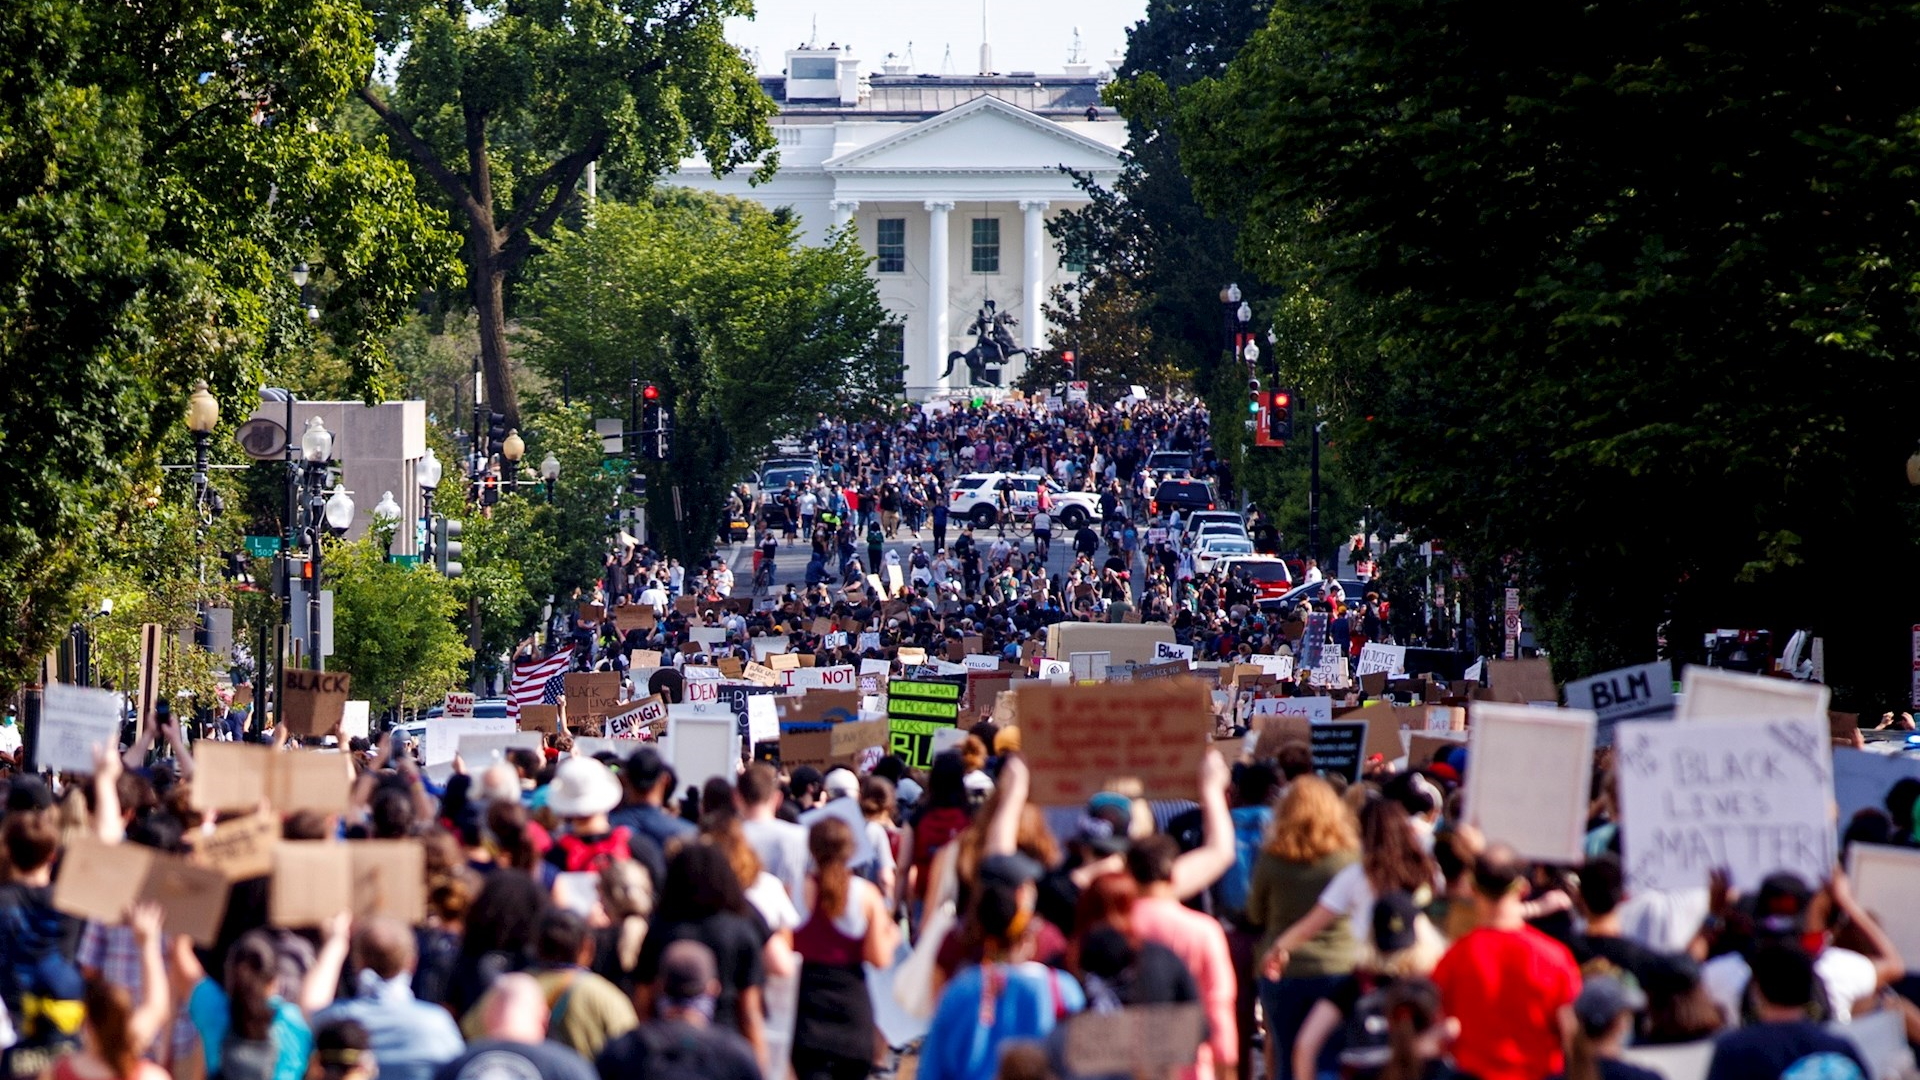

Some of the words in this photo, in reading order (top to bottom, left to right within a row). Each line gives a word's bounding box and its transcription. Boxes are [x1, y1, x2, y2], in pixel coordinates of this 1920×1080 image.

[255, 538, 262, 548] L
[254, 549, 273, 557] 1500
[1158, 643, 1185, 659] Black
[1325, 645, 1339, 655] HAVE
[1321, 665, 1332, 673] TO
[286, 671, 348, 693] BLACK
[782, 670, 795, 687] I
[822, 669, 853, 685] NOT
[1312, 673, 1341, 684] SPEAK
[566, 686, 599, 698] BLACK
[892, 682, 911, 693] THIS
[915, 683, 925, 693] IS
[929, 683, 956, 696] WHAT
[1591, 670, 1651, 709] BLM
[447, 694, 473, 705] White
[590, 698, 617, 708] LIVES
[693, 703, 706, 712] NO
[892, 700, 954, 715] DEMOCRACY
[610, 703, 662, 735] ENOUGH
[890, 719, 923, 732] LOOKS
[1670, 747, 1787, 788] BLACK
[1661, 787, 1772, 818] LIVES
